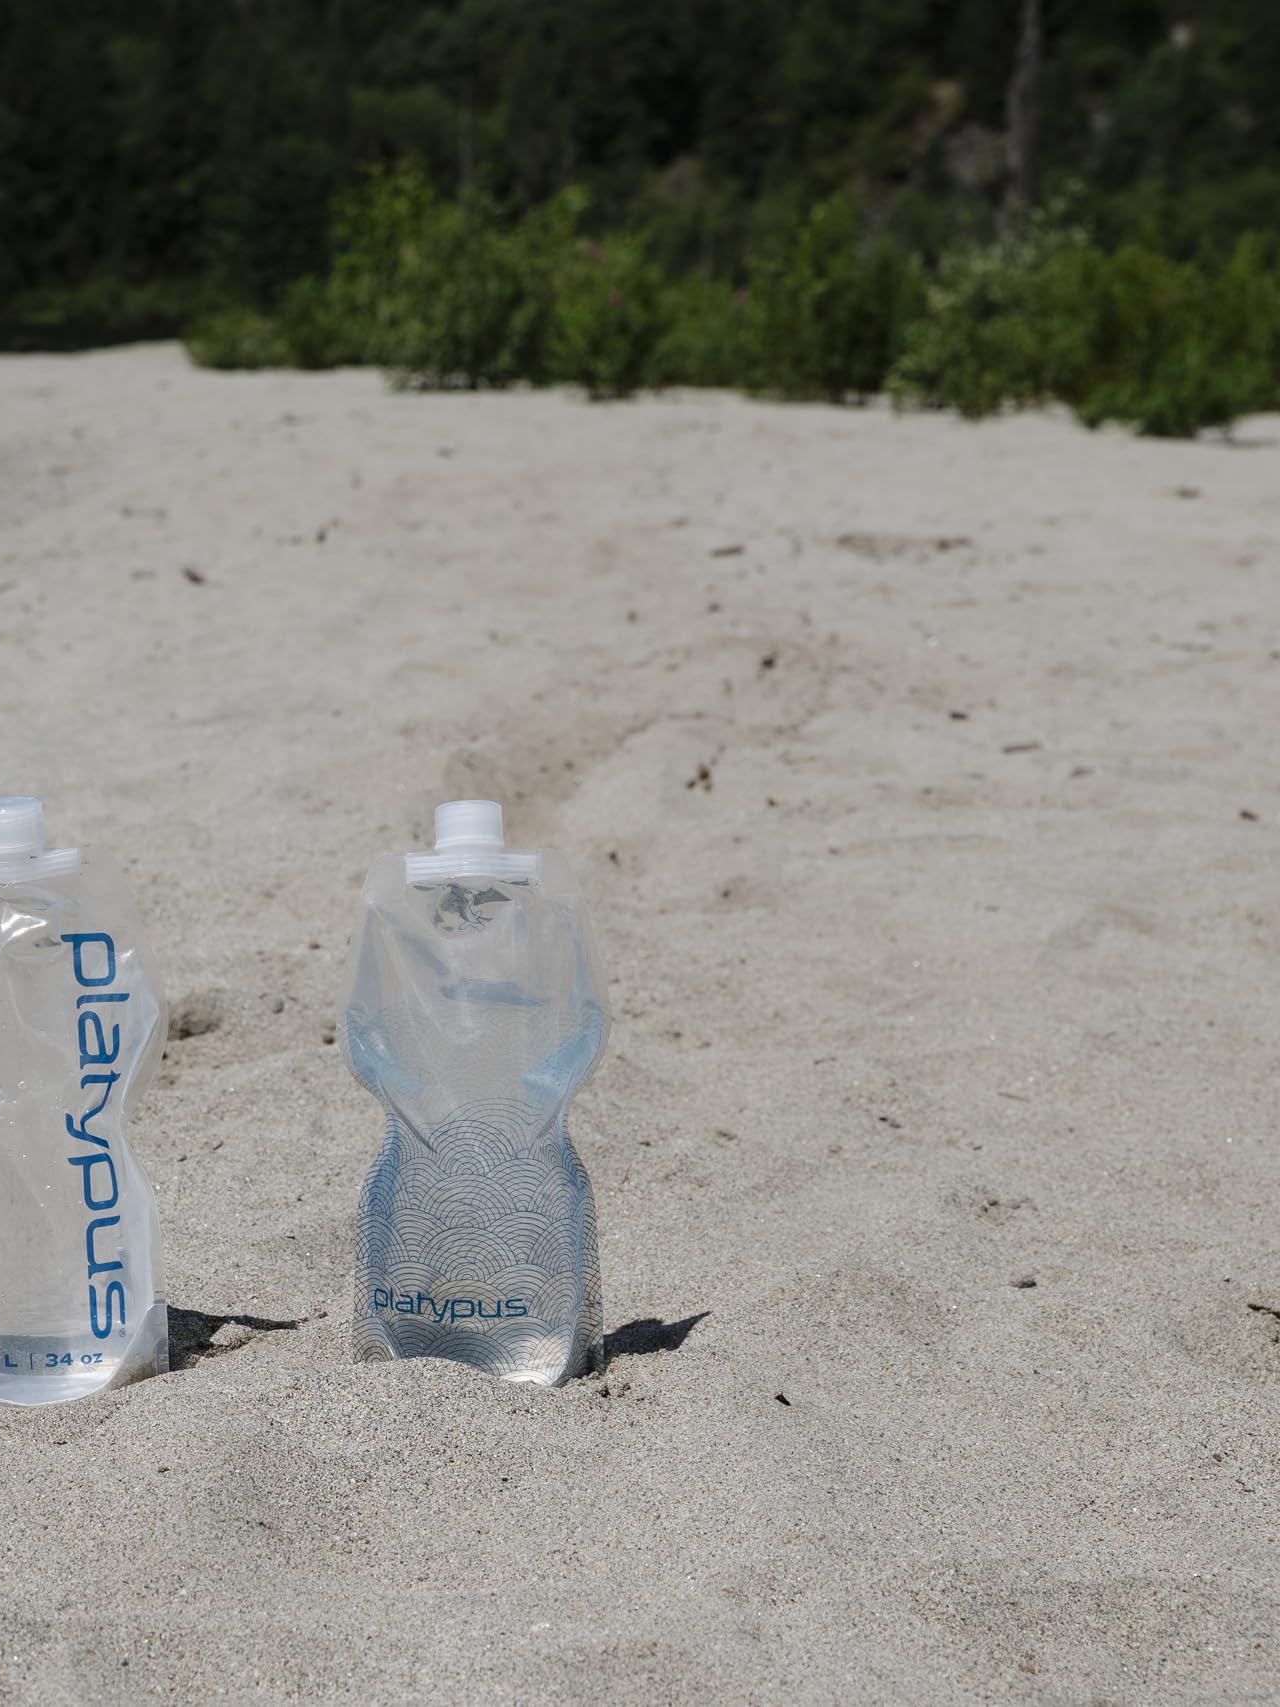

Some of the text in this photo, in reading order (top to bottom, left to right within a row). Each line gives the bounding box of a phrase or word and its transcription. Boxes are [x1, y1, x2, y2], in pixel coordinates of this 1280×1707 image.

[374, 1287, 529, 1324] platypus
[4, 1354, 18, 1368] L
[45, 1353, 73, 1368] 34
